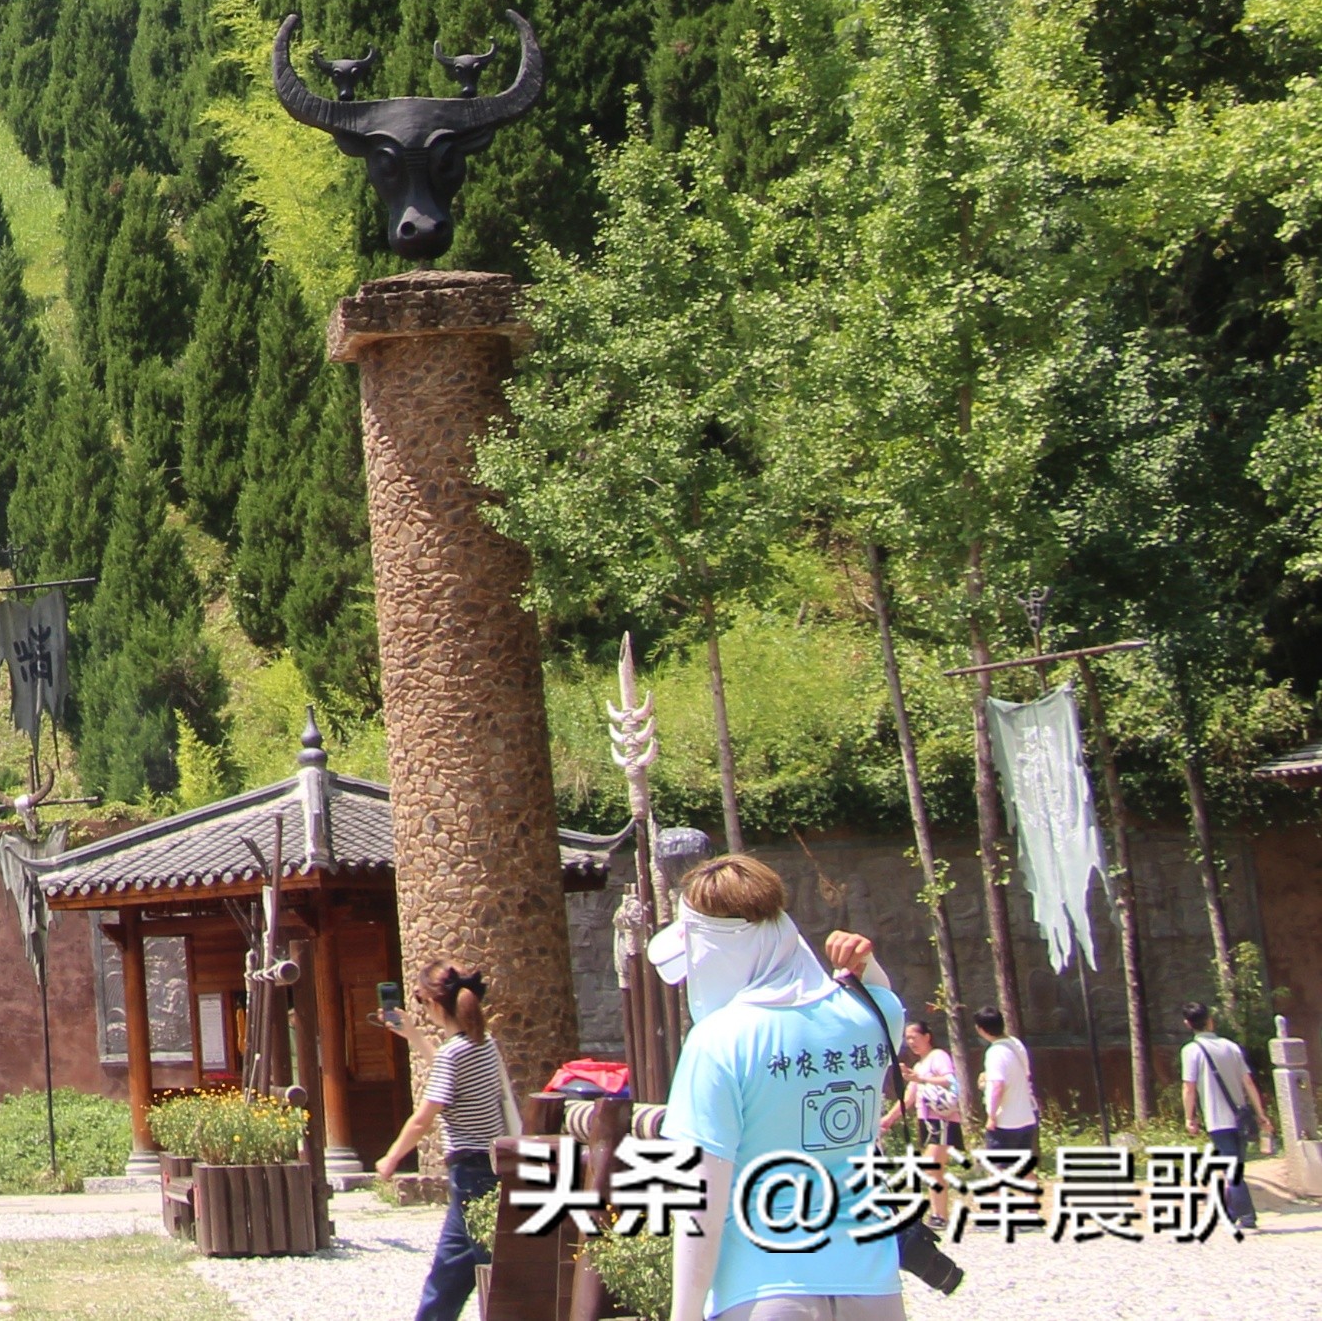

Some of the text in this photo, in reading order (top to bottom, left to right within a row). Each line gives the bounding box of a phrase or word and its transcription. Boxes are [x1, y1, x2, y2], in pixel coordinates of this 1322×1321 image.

[767, 1043, 891, 1081] 神农架摄影
